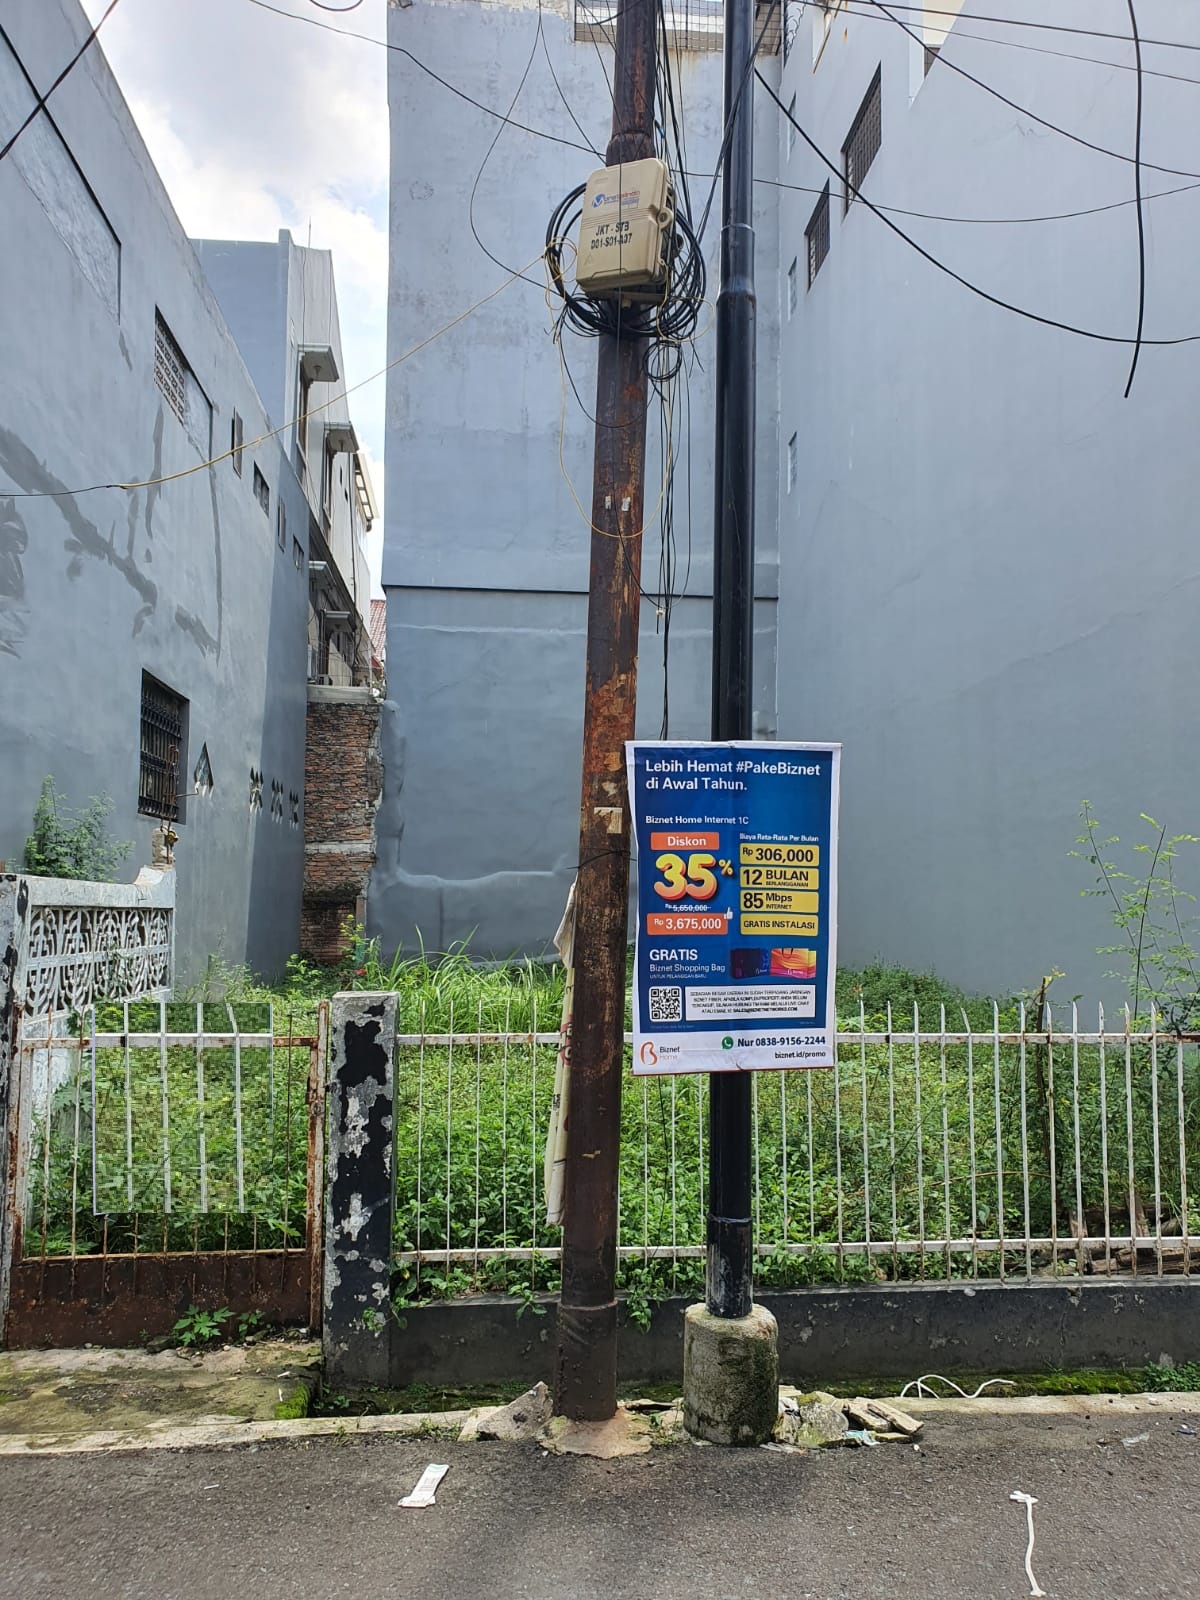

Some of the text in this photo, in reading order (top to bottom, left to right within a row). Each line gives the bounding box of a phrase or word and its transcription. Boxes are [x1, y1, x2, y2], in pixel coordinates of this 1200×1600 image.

[595, 224, 610, 236] JKT
[645, 760, 821, 776] Lebih Hemat #PakeBiznet
[645, 777, 748, 791] di Awal Tahun.
[645, 816, 749, 825] Biznet Home Internet 1C
[667, 836, 707, 847] Diskon
[742, 847, 814, 863] Rp 306,000
[743, 869, 809, 885] 12 BULAN
[743, 892, 793, 909] 85 Mbps
[673, 904, 708, 913] 5,650,000
[654, 918, 722, 930] Rp 3,675,000
[743, 920, 815, 930] GRATIS INSTALASI
[649, 949, 698, 961] GRATIS
[649, 963, 726, 973] Biznet Shopping Bag
[737, 1036, 826, 1048] Nur 0838-9156-2244
[774, 1050, 826, 1060] biznet.id/promo
